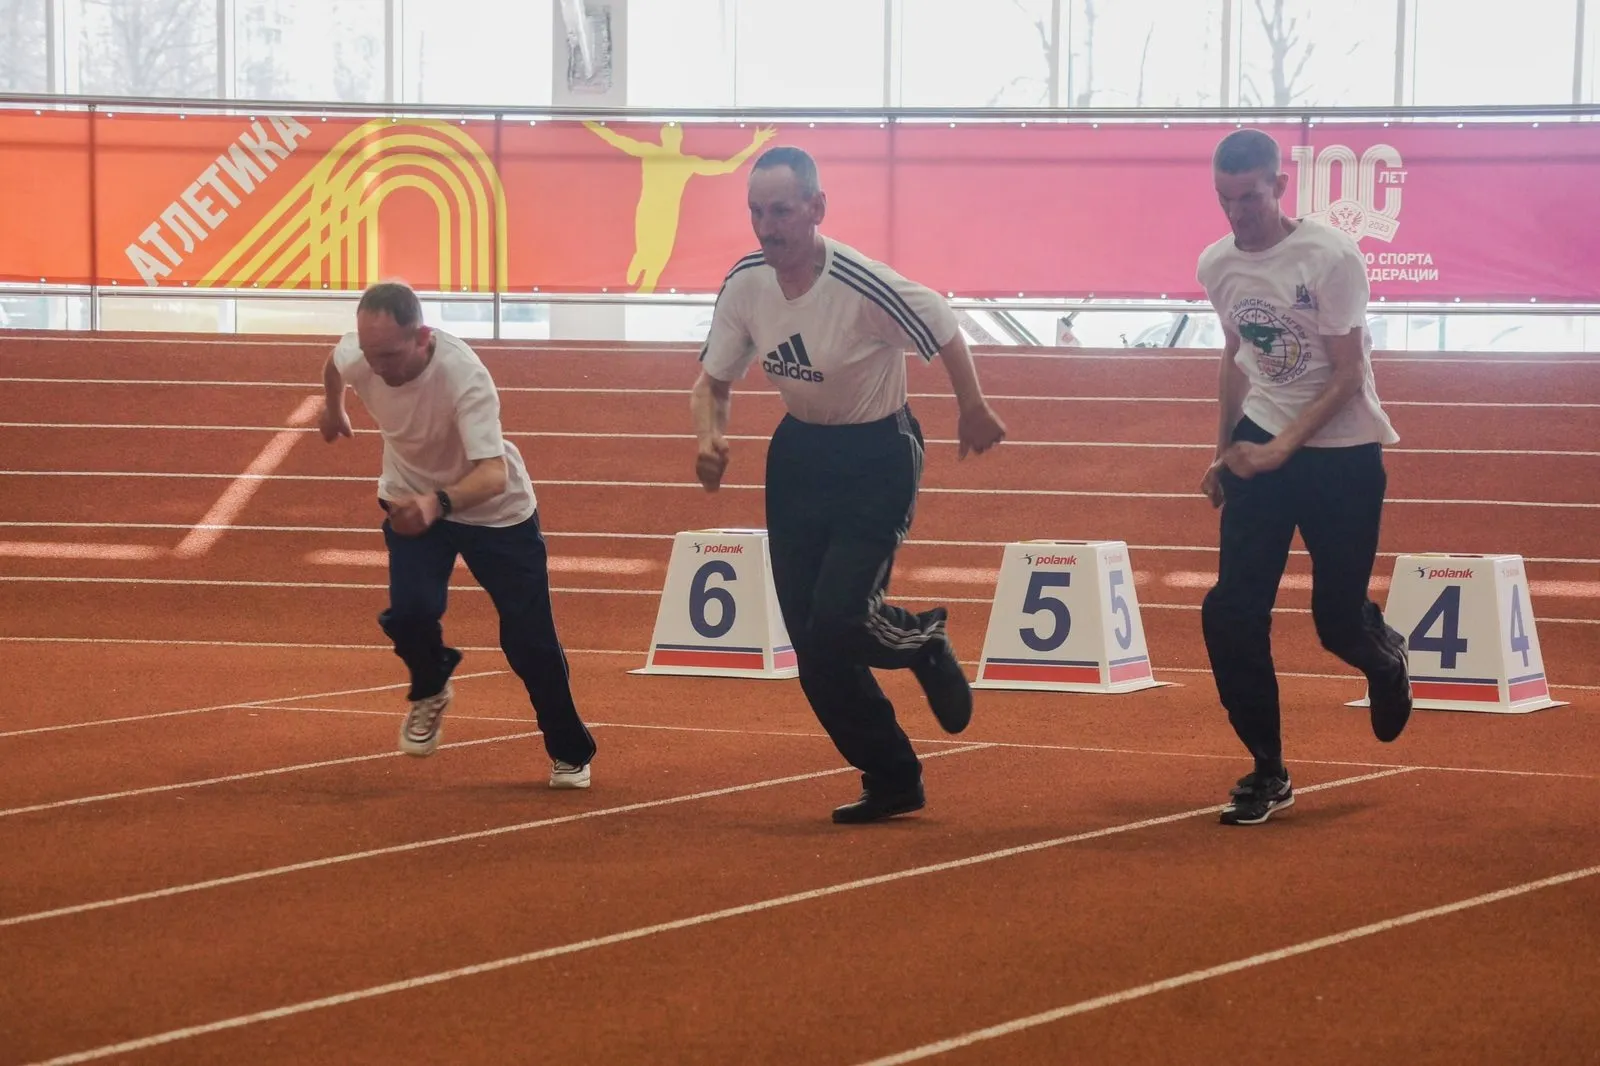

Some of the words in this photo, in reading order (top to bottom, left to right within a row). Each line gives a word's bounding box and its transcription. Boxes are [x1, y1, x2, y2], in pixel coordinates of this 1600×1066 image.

[1378, 171, 1408, 184] ЛЕТ
[125, 116, 312, 287] АТЛЕТИКА
[1368, 220, 1390, 233] 2023
[1379, 253, 1433, 265] СПОРТА
[762, 360, 825, 383] adidas
[704, 544, 744, 554] polanik
[1035, 555, 1077, 566] polanik
[1428, 568, 1473, 579] polanik
[689, 560, 737, 638] 6
[1109, 569, 1132, 650] 5
[1019, 571, 1071, 652] 5
[1408, 585, 1467, 669] 4
[1511, 584, 1529, 667] 4
